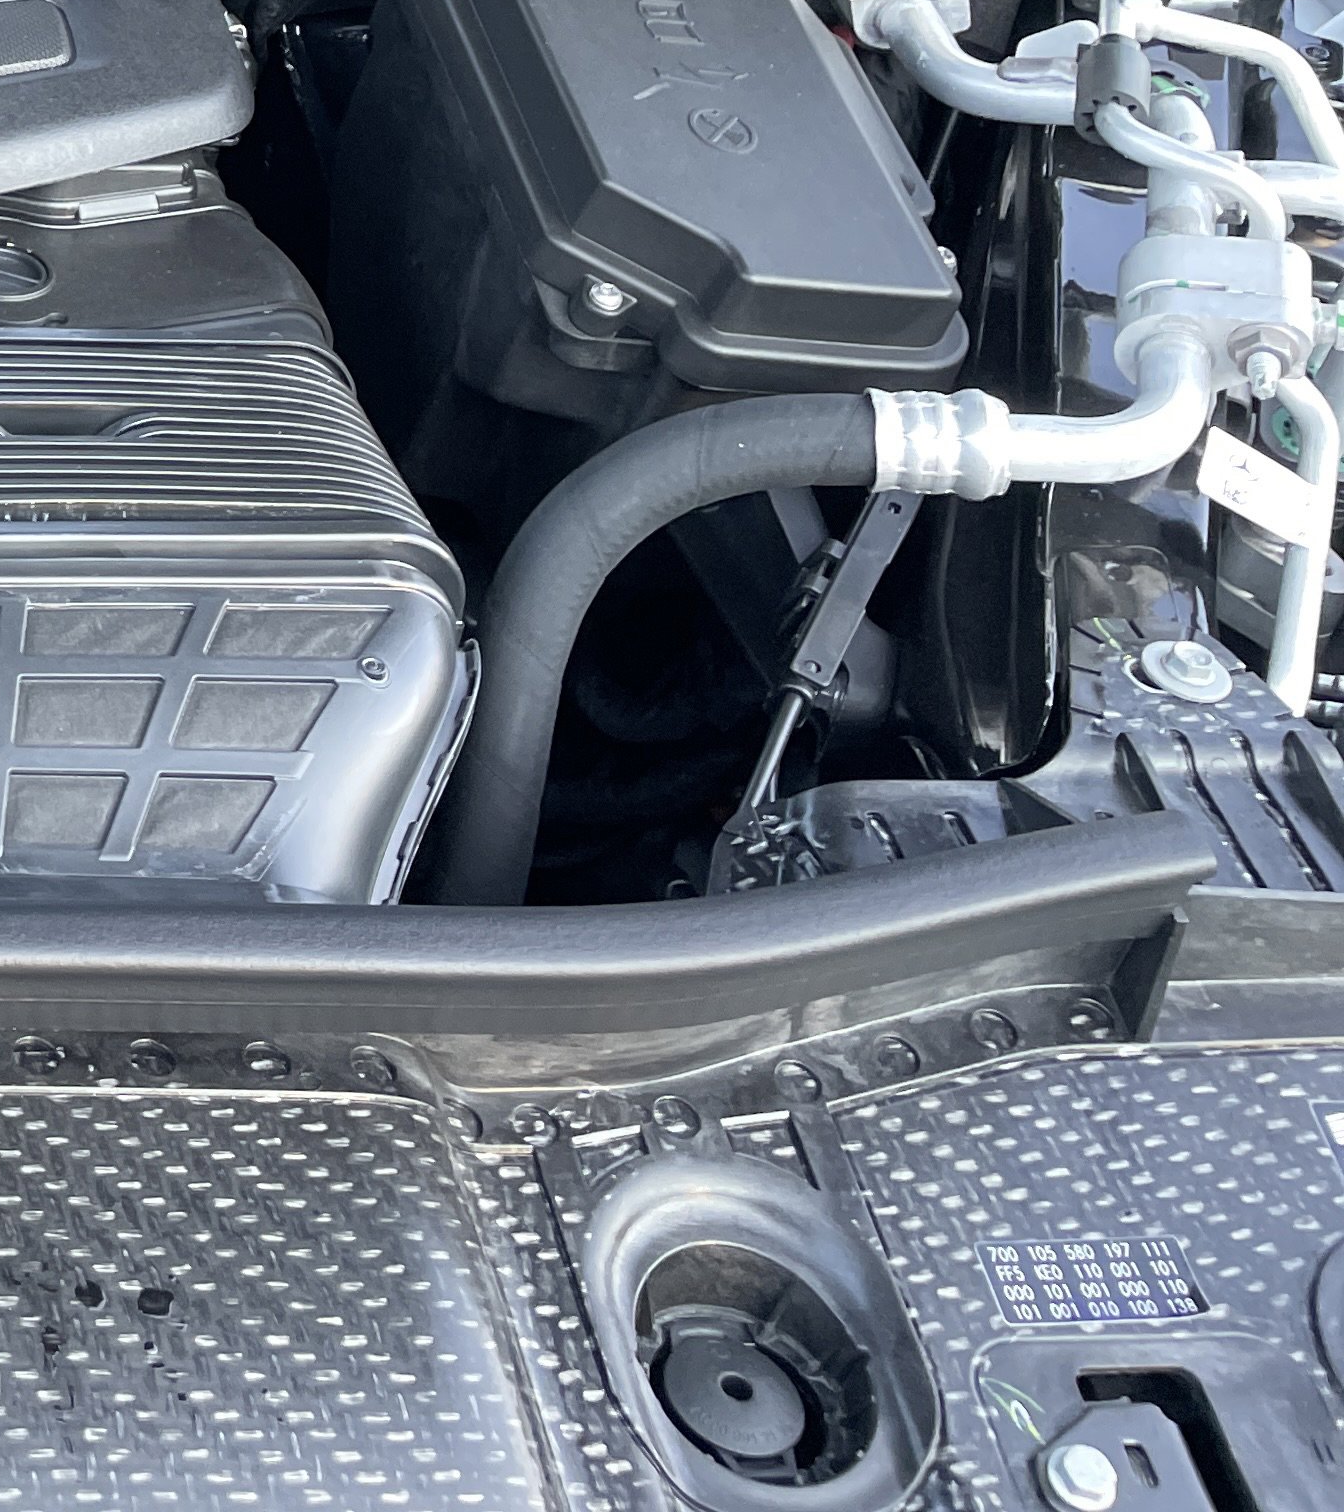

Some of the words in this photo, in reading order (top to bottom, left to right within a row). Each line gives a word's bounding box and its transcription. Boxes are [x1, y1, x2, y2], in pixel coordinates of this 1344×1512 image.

[987, 1245, 1019, 1262] 700
[1027, 1245, 1057, 1261] 105
[1063, 1244, 1095, 1260] 580
[1103, 1242, 1130, 1258] 197
[1141, 1241, 1170, 1257] 111
[995, 1265, 1025, 1281] FF5
[1073, 1262, 1103, 1279] 110
[1109, 1261, 1141, 1278] 001
[1149, 1259, 1179, 1276] 101
[1003, 1284, 1035, 1301] 000
[1043, 1283, 1072, 1300] 101
[1079, 1282, 1110, 1299] 001
[1118, 1280, 1150, 1298] 000
[1158, 1278, 1189, 1296] 110
[1013, 1303, 1042, 1320] 101
[1049, 1302, 1080, 1319] 001
[1088, 1300, 1120, 1318] 010
[1128, 1299, 1159, 1316] 100
